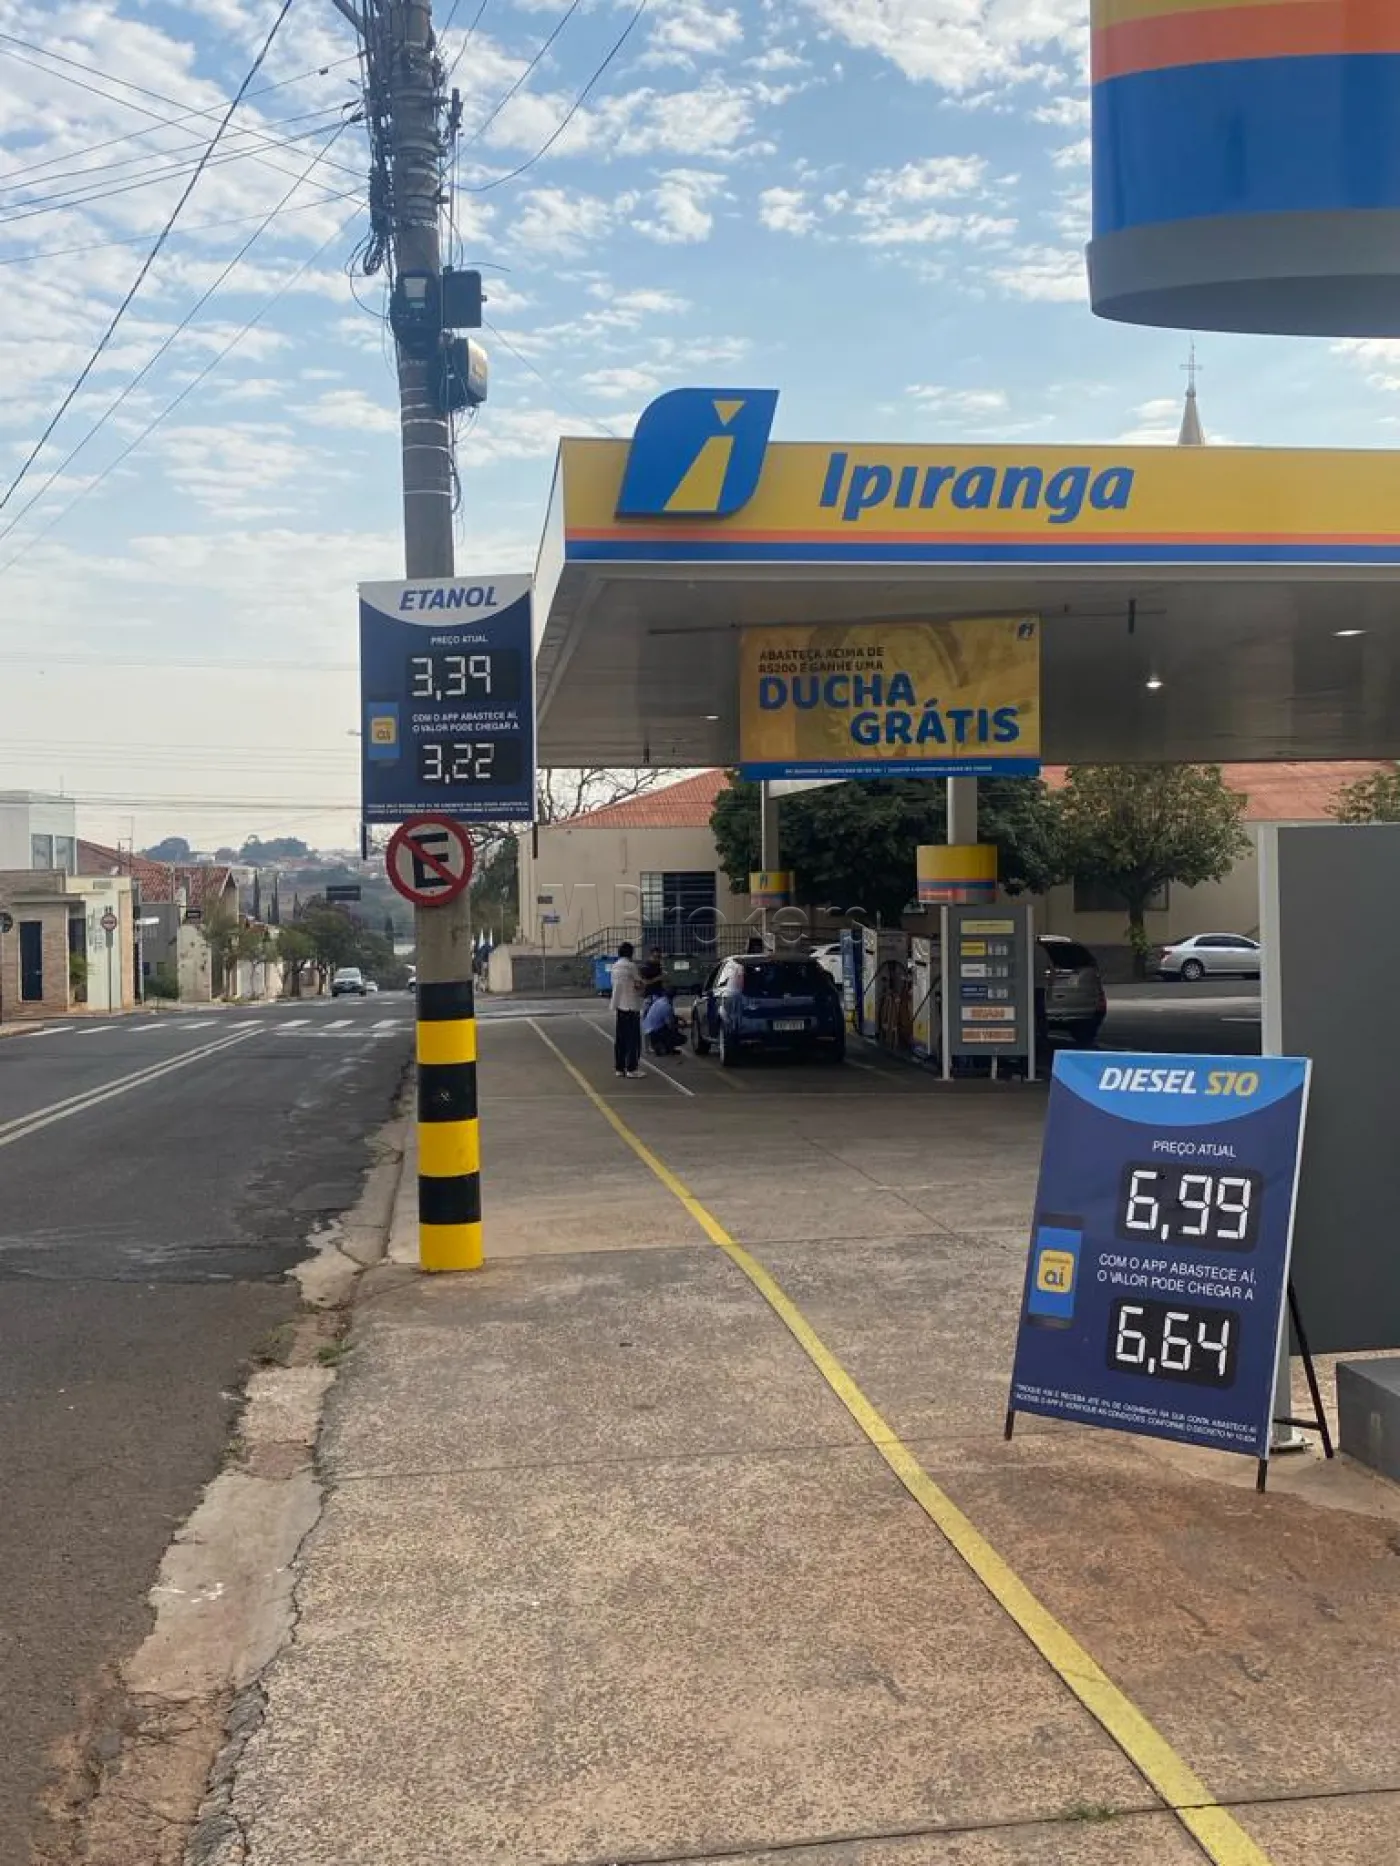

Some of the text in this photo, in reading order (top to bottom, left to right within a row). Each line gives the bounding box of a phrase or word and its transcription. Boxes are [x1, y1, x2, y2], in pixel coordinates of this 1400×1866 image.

[820, 451, 1136, 525] Ipiranga
[399, 586, 498, 611] ETANOL
[430, 635, 488, 646] PREÇO ATUAL
[760, 646, 885, 661] ABASTEÇA ACIMA DE
[411, 655, 491, 701] 3,39
[799, 662, 807, 672] E
[808, 661, 852, 672] GANHE
[855, 660, 884, 671] UMA
[758, 671, 916, 710] DUCHA
[450, 723, 473, 732] PODE
[475, 721, 511, 731] CHEGAR
[460, 711, 505, 721] ABASTECE
[850, 697, 1020, 746] GRÁTIS
[422, 743, 495, 784] 3,22
[411, 832, 449, 889] E
[1099, 1067, 1260, 1096] DIESEL S10
[1153, 1140, 1237, 1158] PREÇO ATUAL
[1126, 1170, 1252, 1241] 6,99
[1099, 1253, 1128, 1268] COM
[1129, 1256, 1140, 1269] O
[1141, 1258, 1168, 1272] APP
[1169, 1262, 1237, 1282] ABASTECE
[1097, 1269, 1254, 1301] O VALOR PODE CHEGAR A
[1116, 1305, 1230, 1377] 6,64
